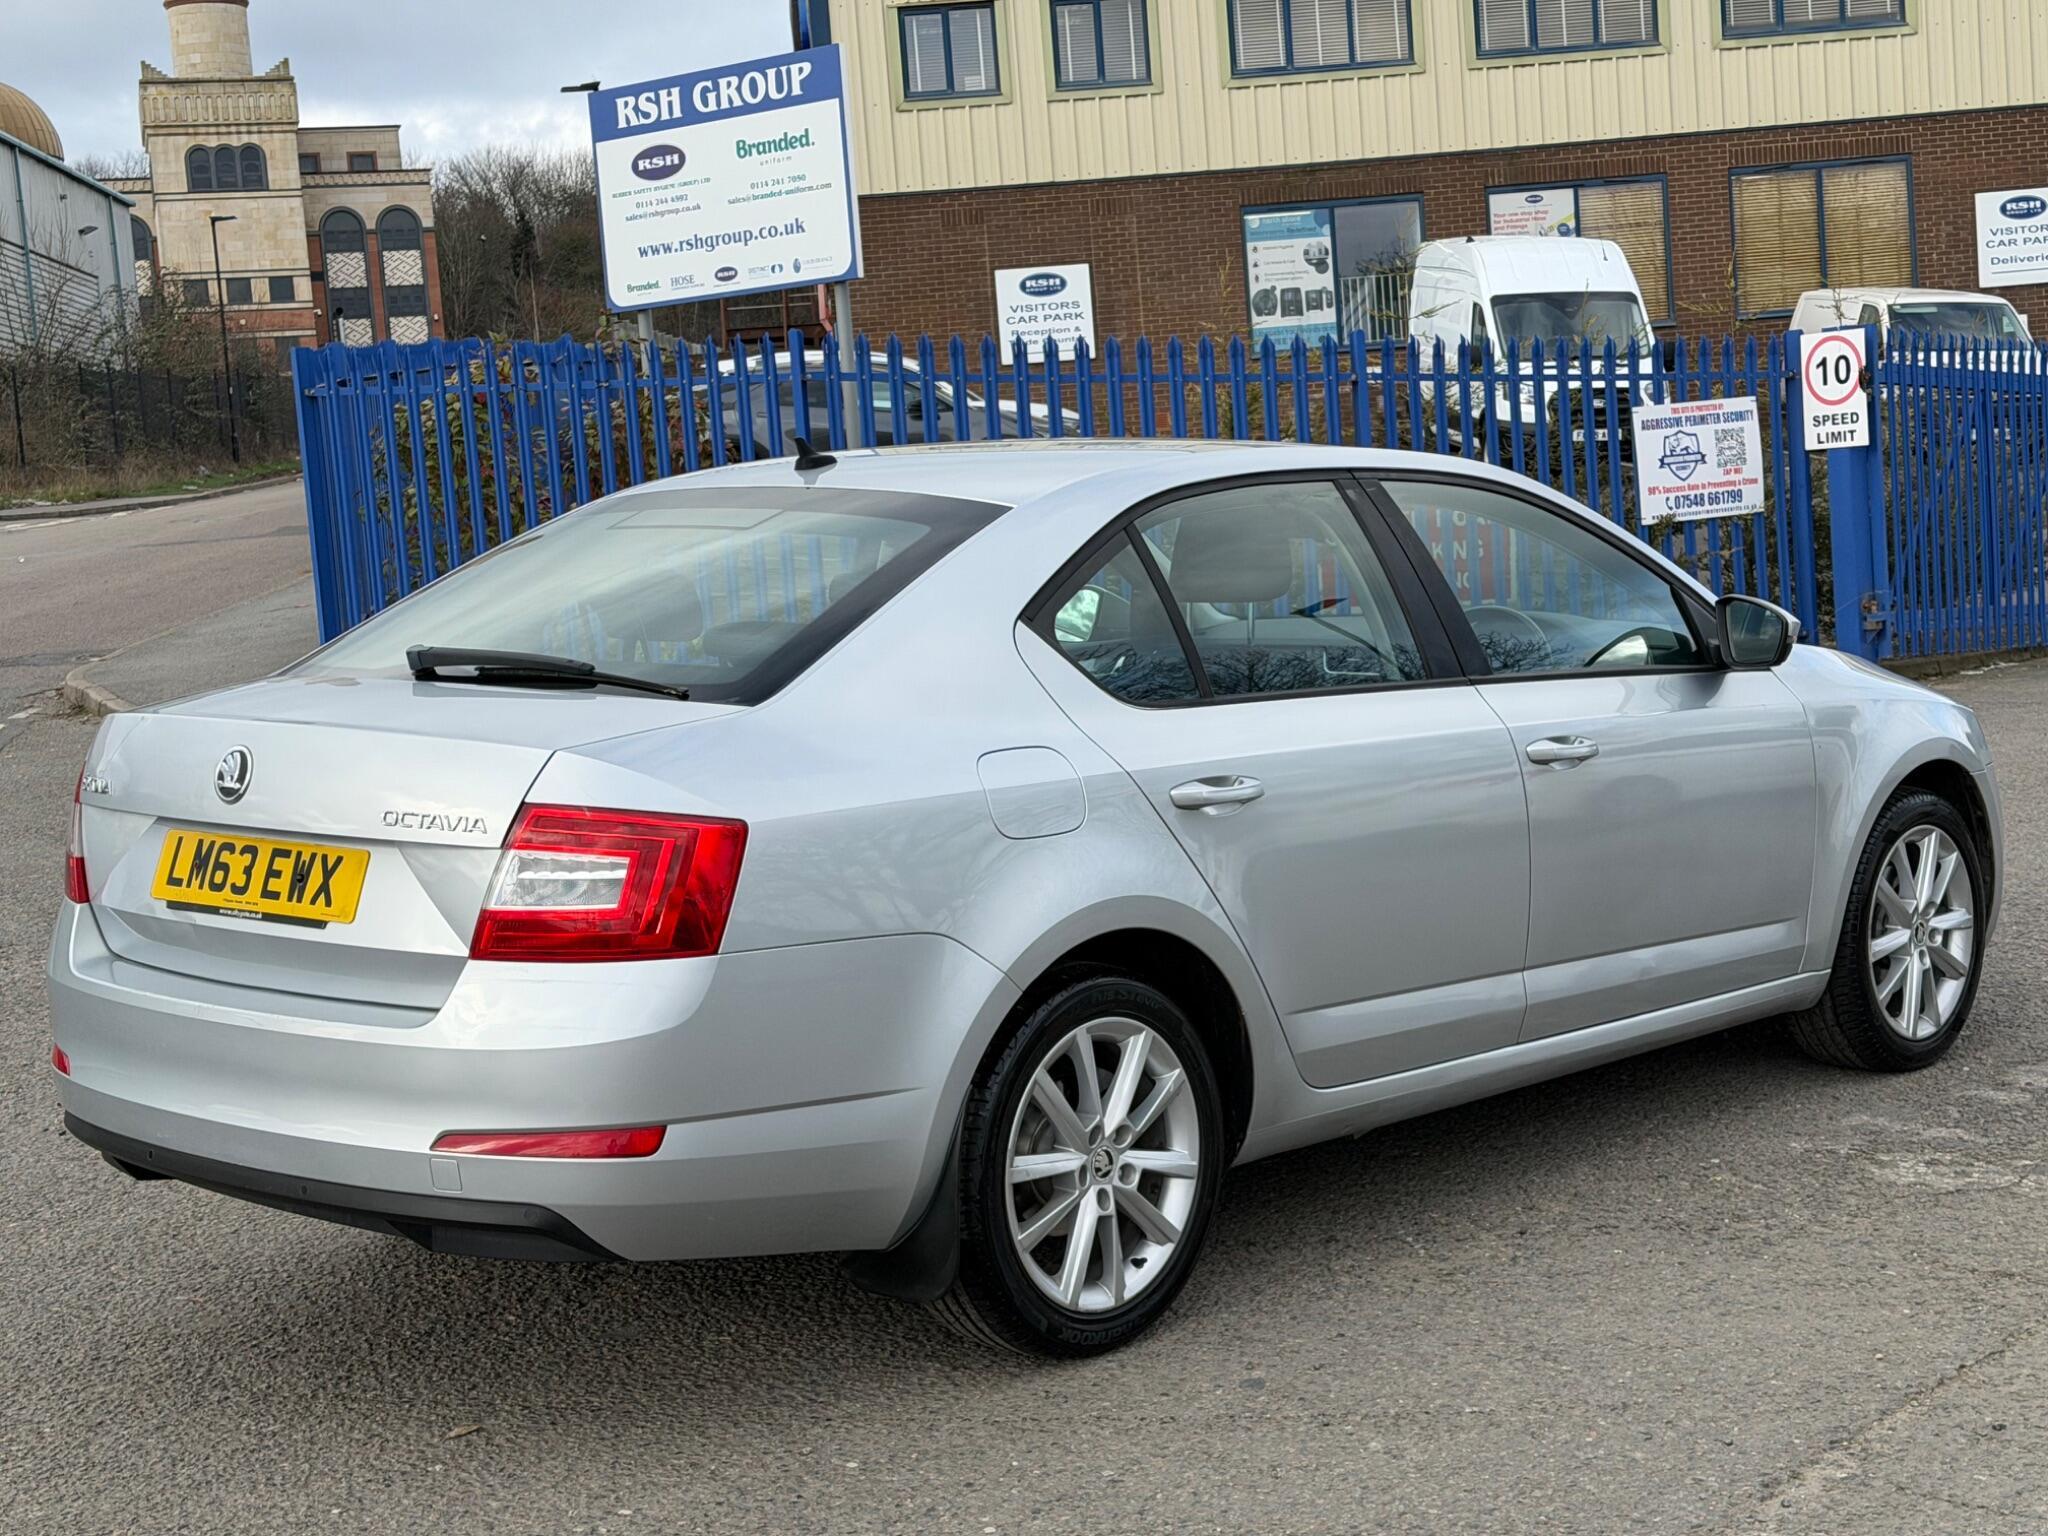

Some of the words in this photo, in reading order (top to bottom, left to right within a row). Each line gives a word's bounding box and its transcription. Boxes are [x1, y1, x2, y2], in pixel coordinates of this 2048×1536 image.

[615, 87, 683, 129] RSH
[692, 61, 812, 113] GROUP
[736, 128, 815, 159] Branded.
[638, 153, 679, 171] RSH
[2006, 200, 2041, 210] RSH
[637, 218, 807, 258] www.rshgroup.co.uk
[1986, 239, 2018, 249] CAR
[670, 274, 695, 287] HOSE
[1025, 278, 1061, 288] RSH
[1009, 300, 1081, 313] VISITORS
[1006, 315, 1039, 325] CAR
[1043, 312, 1085, 323] PARK
[1011, 326, 1071, 337] Reception
[1815, 354, 1851, 387] 10
[1641, 416, 1684, 431] AGGRESSIVE
[1684, 412, 1721, 428] PERIMETER
[1722, 409, 1754, 424] SECURITY
[1812, 411, 1860, 428] SPEED
[1817, 429, 1857, 445] LIMIT
[1663, 483, 1687, 494] Success
[1707, 478, 1737, 490] Preventing
[1675, 492, 1706, 511] 07548
[1707, 489, 1743, 506] 661799
[380, 809, 488, 835] OCTAVIA
[165, 834, 258, 896] LM63
[261, 848, 344, 908] EWX
